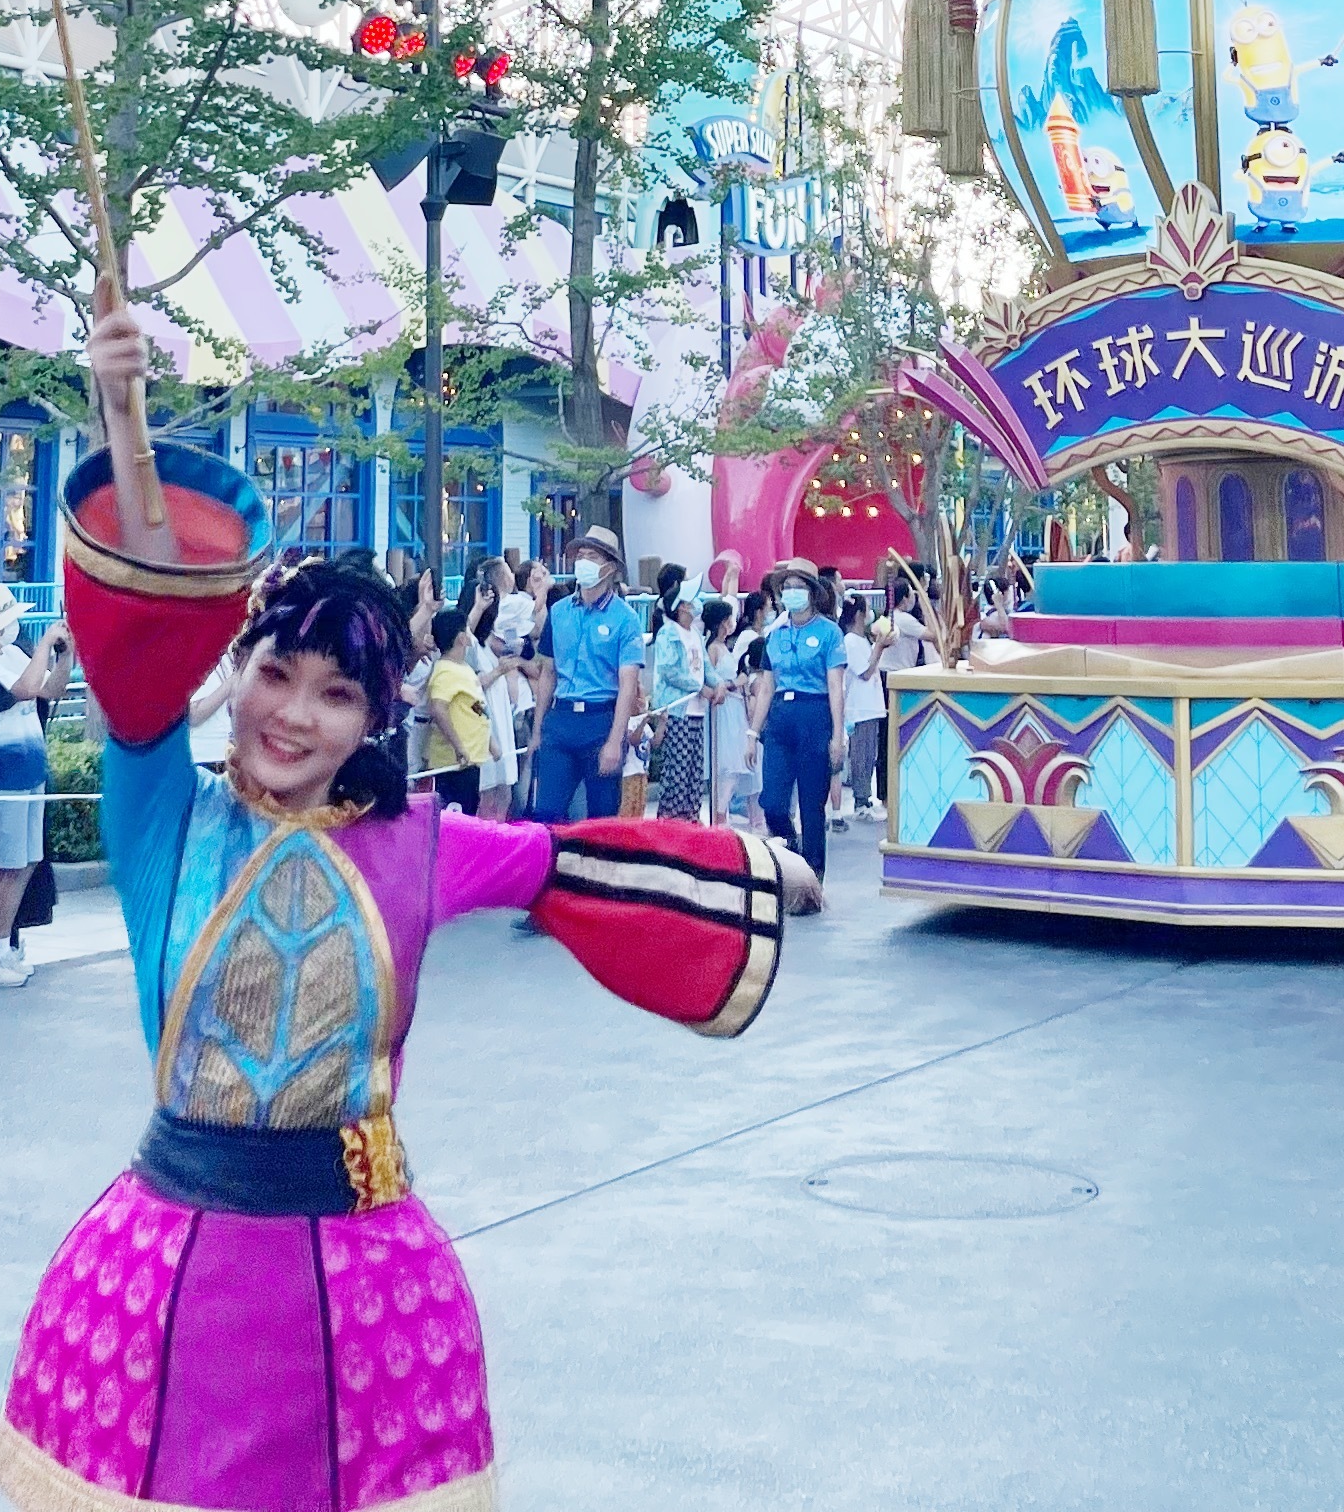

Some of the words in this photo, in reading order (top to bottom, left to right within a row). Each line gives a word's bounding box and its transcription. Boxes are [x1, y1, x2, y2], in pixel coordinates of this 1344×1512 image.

[706, 120, 750, 161] SUPER
[750, 126, 777, 163] SILLY
[747, 181, 807, 250] FUN
